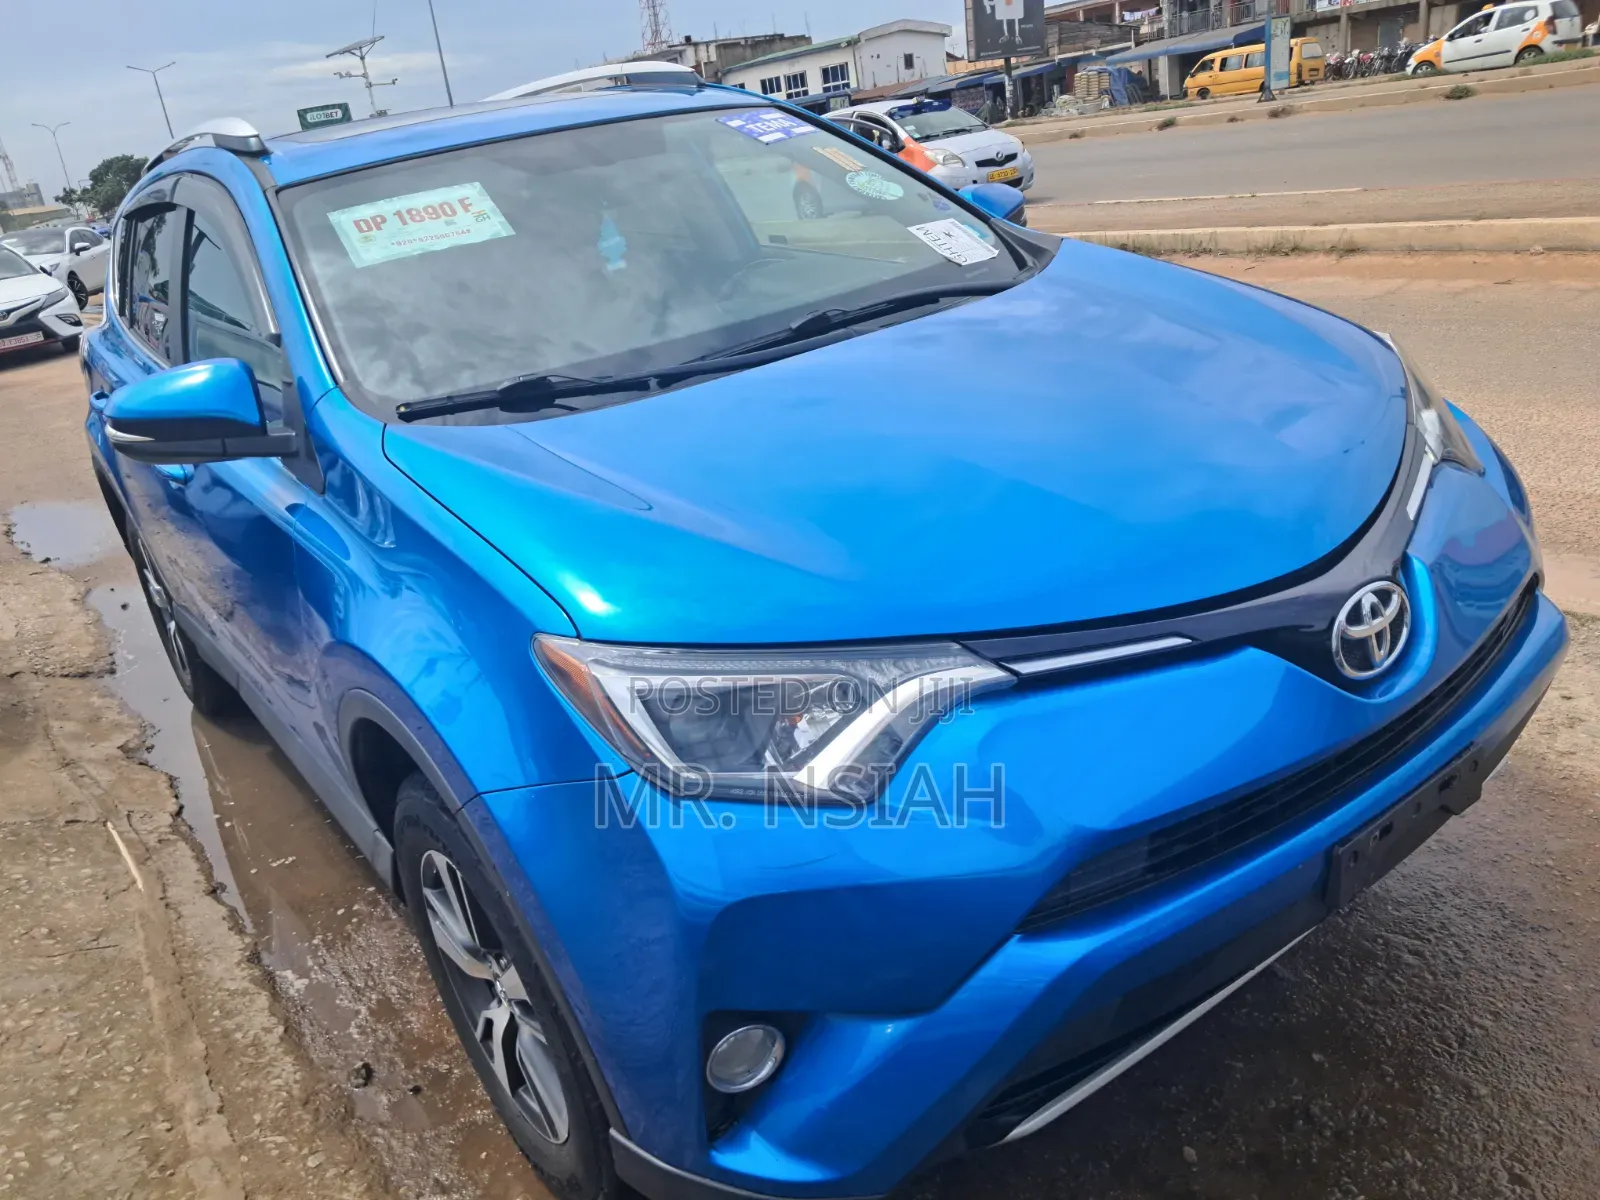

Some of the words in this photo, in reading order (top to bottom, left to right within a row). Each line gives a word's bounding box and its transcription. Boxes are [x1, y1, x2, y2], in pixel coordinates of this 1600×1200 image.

[744, 118, 797, 133] TEMA
[352, 217, 388, 234] DP
[392, 201, 458, 227] 1890
[459, 197, 474, 214] F
[475, 214, 491, 224] GH
